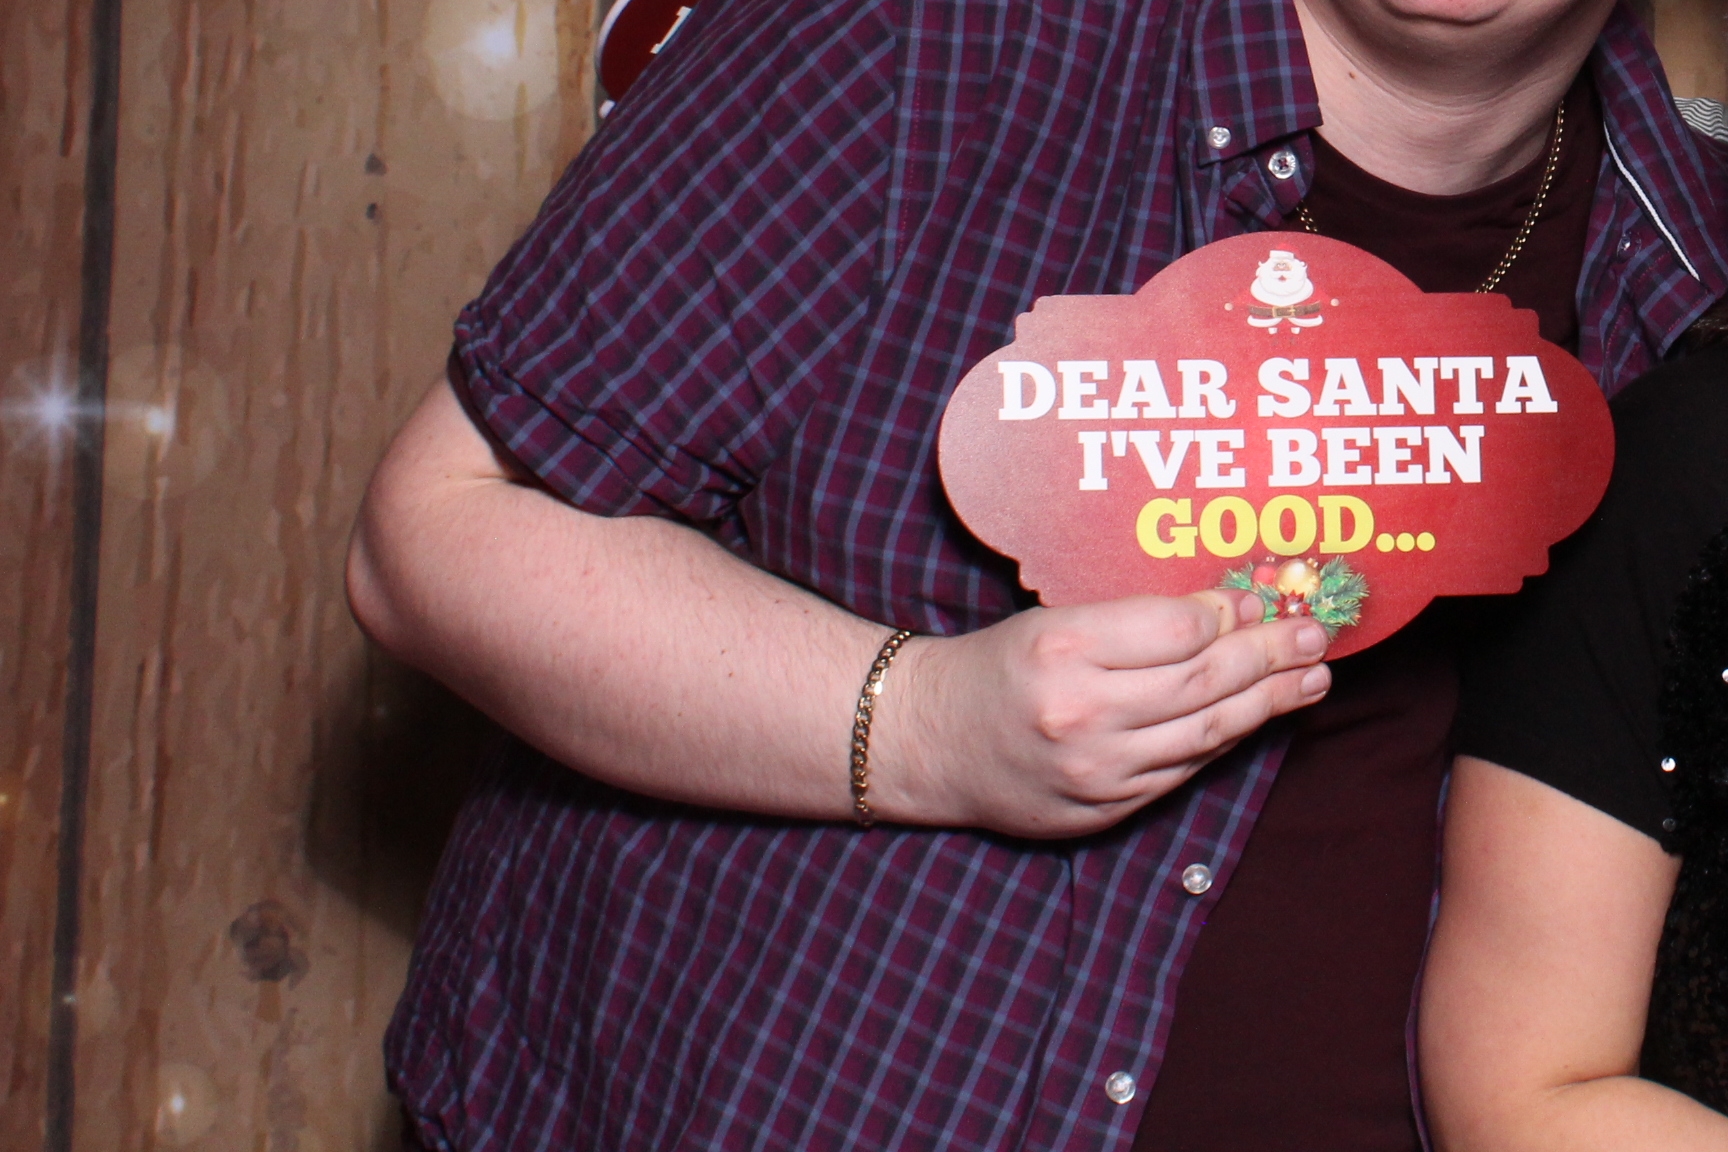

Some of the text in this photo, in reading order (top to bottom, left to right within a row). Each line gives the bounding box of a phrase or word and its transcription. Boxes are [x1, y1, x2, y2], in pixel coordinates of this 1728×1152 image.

[999, 356, 1558, 421] DEAR SANTA
[1078, 425, 1485, 490] I'VE BEEN
[1136, 495, 1435, 558] GOOD...
